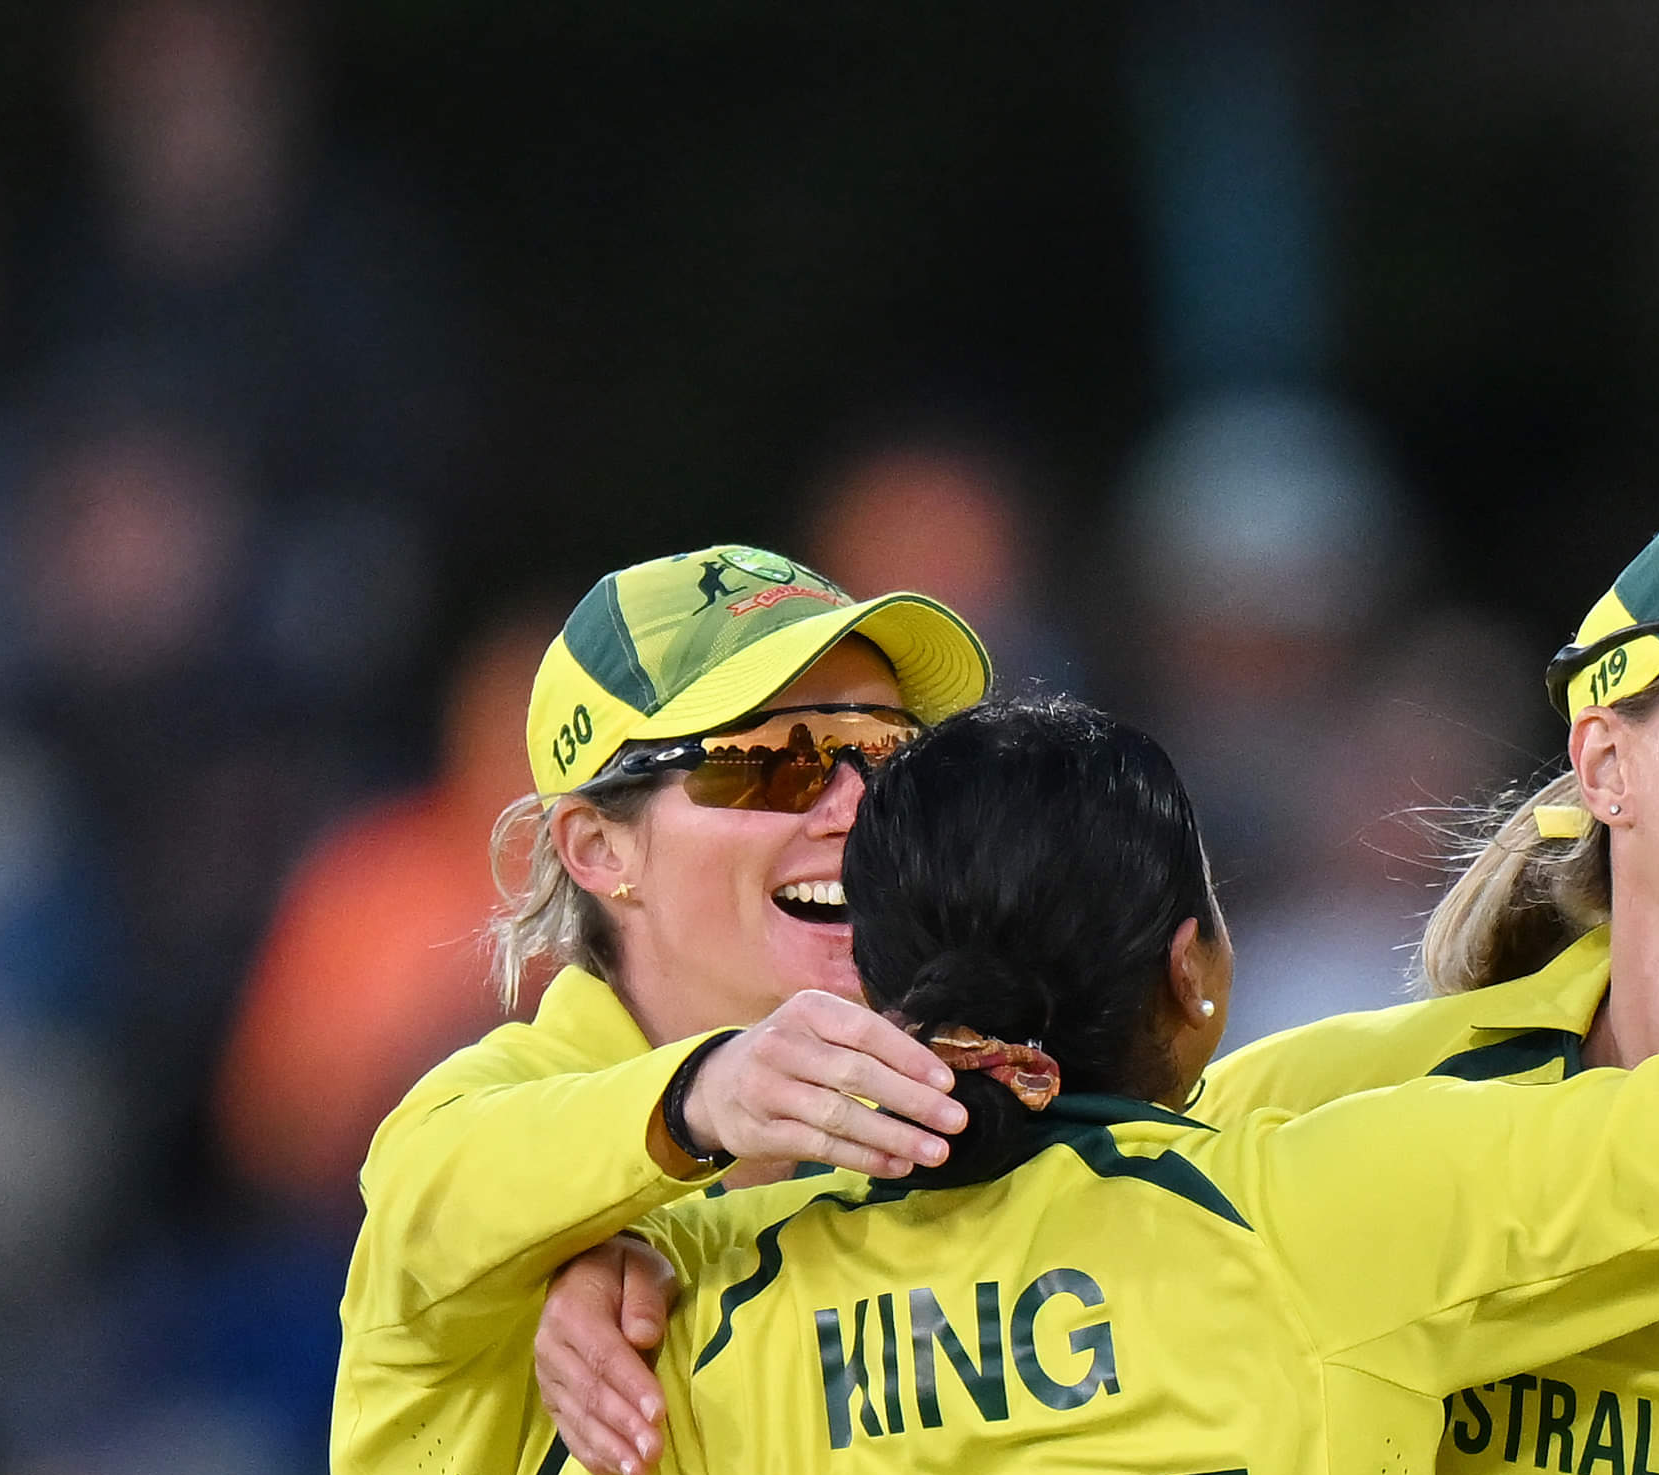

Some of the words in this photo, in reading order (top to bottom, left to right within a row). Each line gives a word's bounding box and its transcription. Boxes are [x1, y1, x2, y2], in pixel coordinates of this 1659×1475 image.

[1589, 647, 1628, 706] 119
[552, 703, 593, 777] 130
[814, 1266, 1120, 1450] KING
